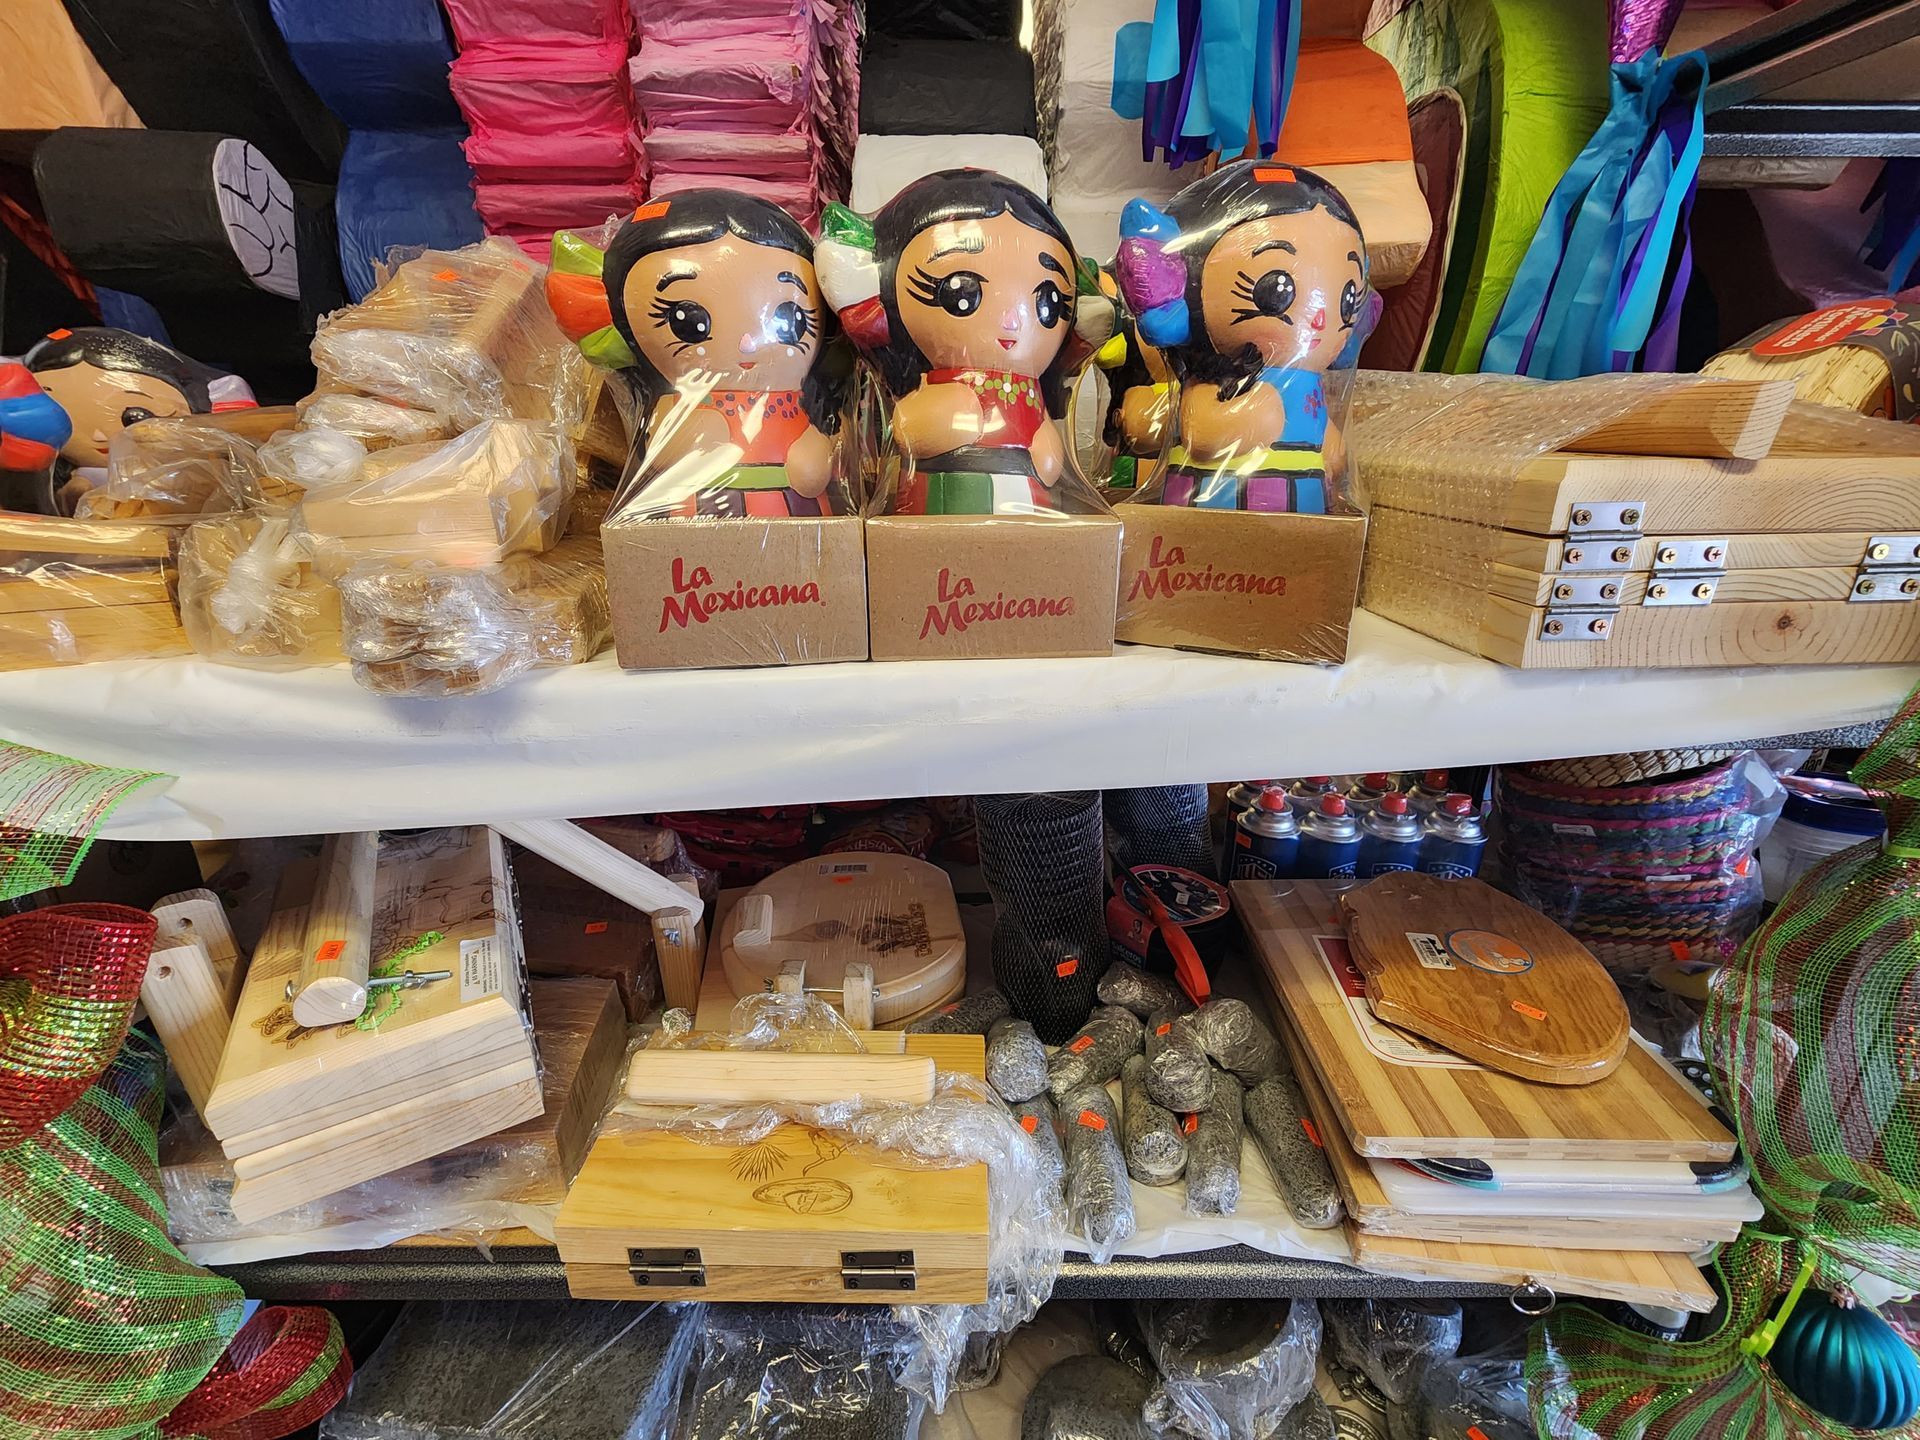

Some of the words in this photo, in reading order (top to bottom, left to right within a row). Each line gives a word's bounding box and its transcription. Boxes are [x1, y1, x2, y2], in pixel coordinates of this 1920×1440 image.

[1149, 535, 1187, 569] La
[671, 556, 714, 594] La
[937, 567, 976, 603] La
[1126, 563, 1287, 602] Mexicana
[658, 580, 821, 633] Mexicana
[918, 591, 1077, 641] Mexicana
